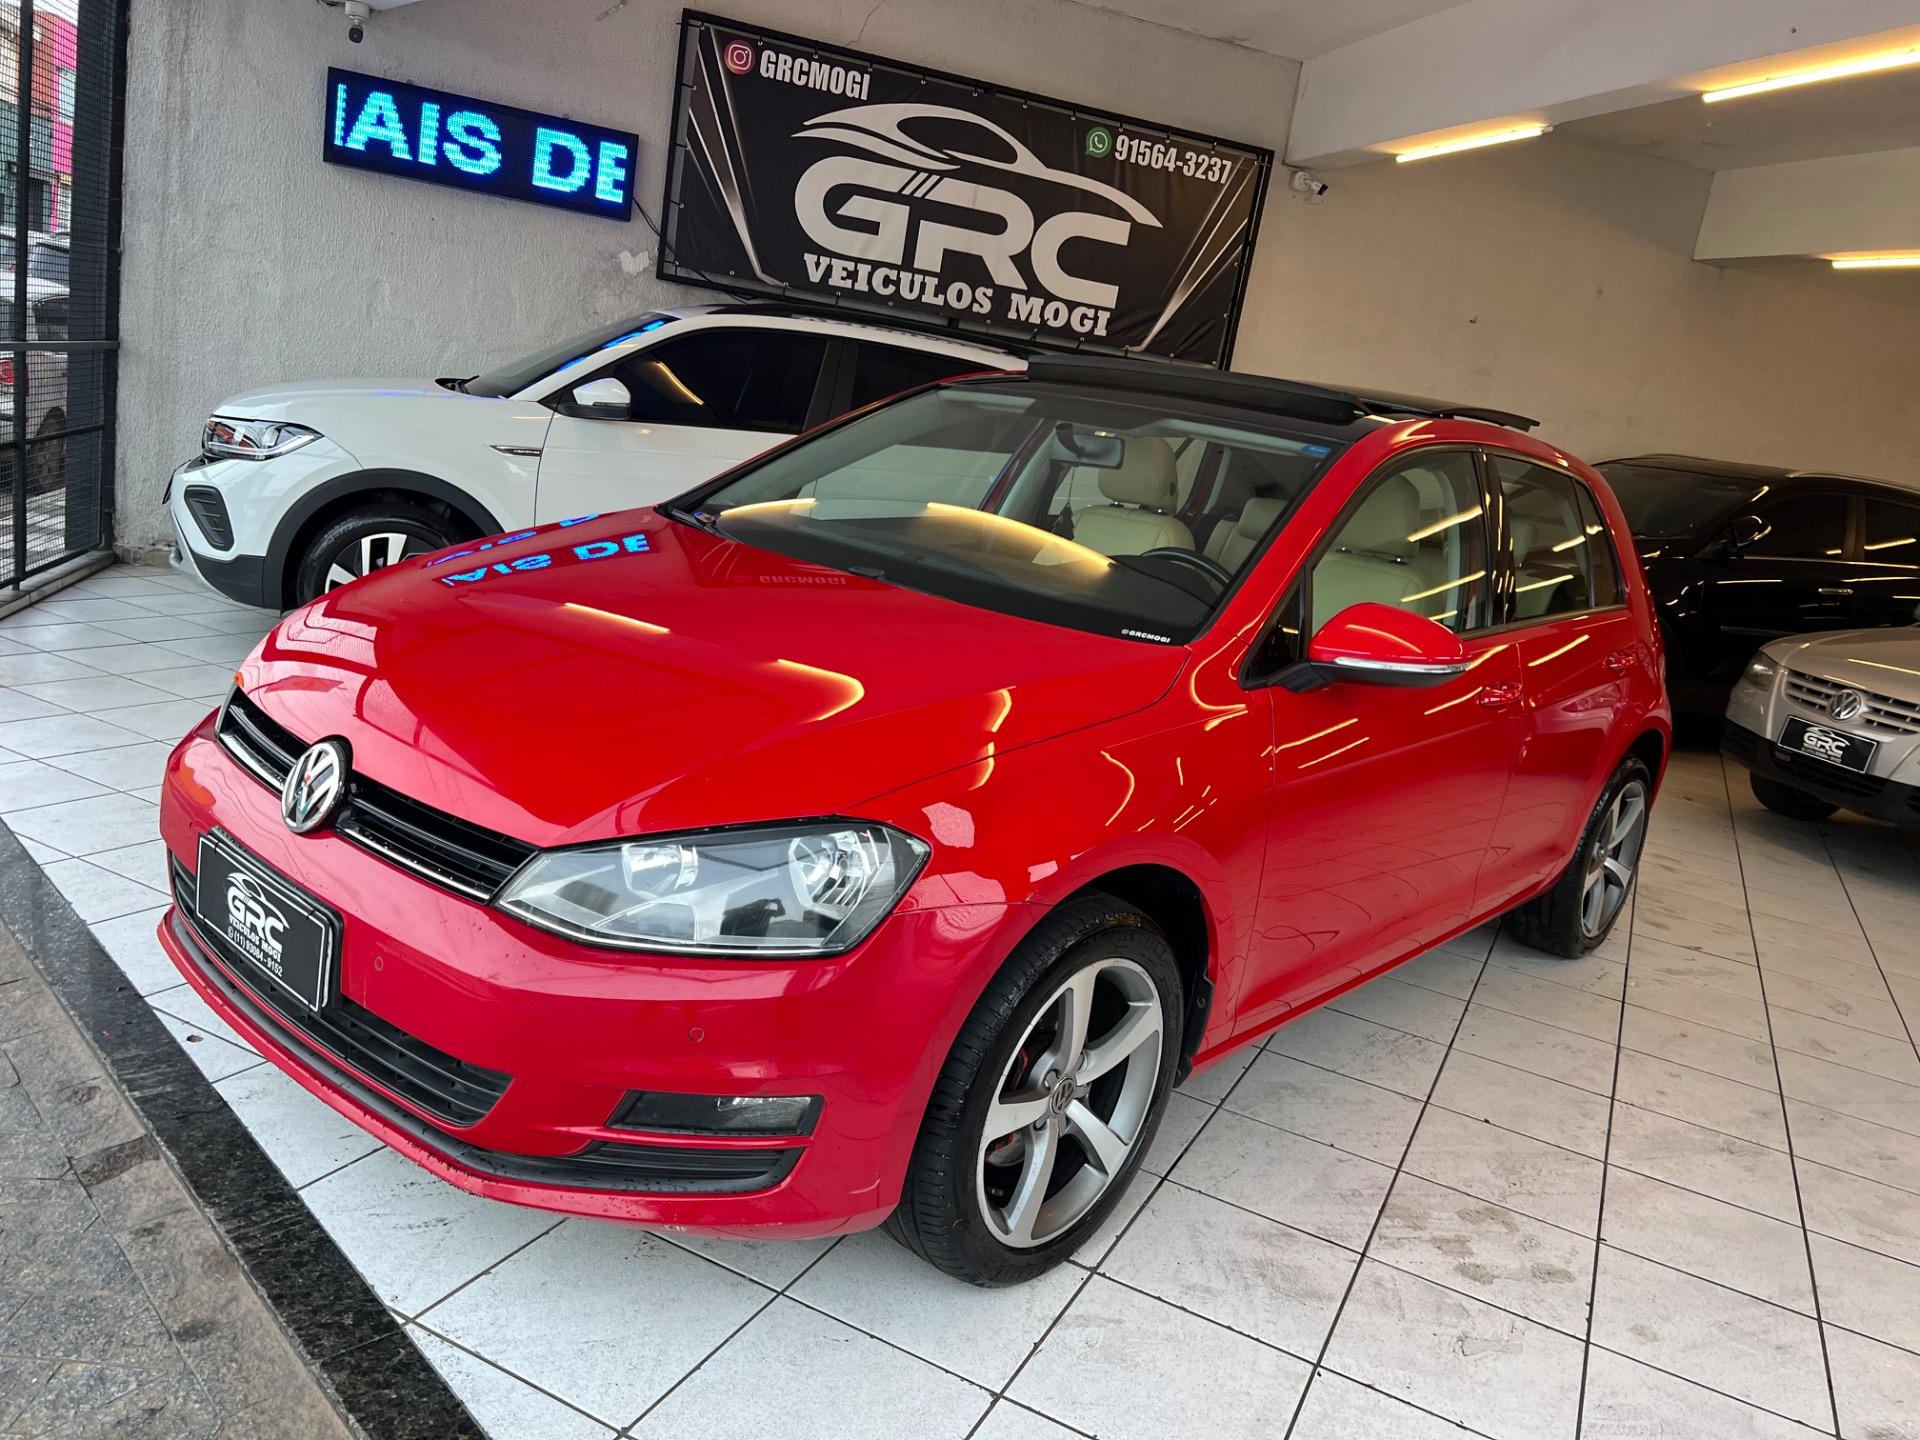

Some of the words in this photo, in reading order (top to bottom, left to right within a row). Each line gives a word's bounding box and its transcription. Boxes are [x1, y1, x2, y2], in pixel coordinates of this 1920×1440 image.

[759, 50, 871, 100] GRCMOGI
[334, 83, 501, 176] AIS
[532, 126, 627, 203] DE
[1114, 134, 1232, 184] 91564-3237
[795, 156, 1131, 309] GRC
[803, 253, 993, 314] VEICULOS
[1008, 293, 1111, 336] MOGI
[1803, 731, 1846, 755] GRC
[227, 885, 284, 953] GRC
[228, 913, 260, 945] VEICULOS
[261, 938, 281, 962] MOGI
